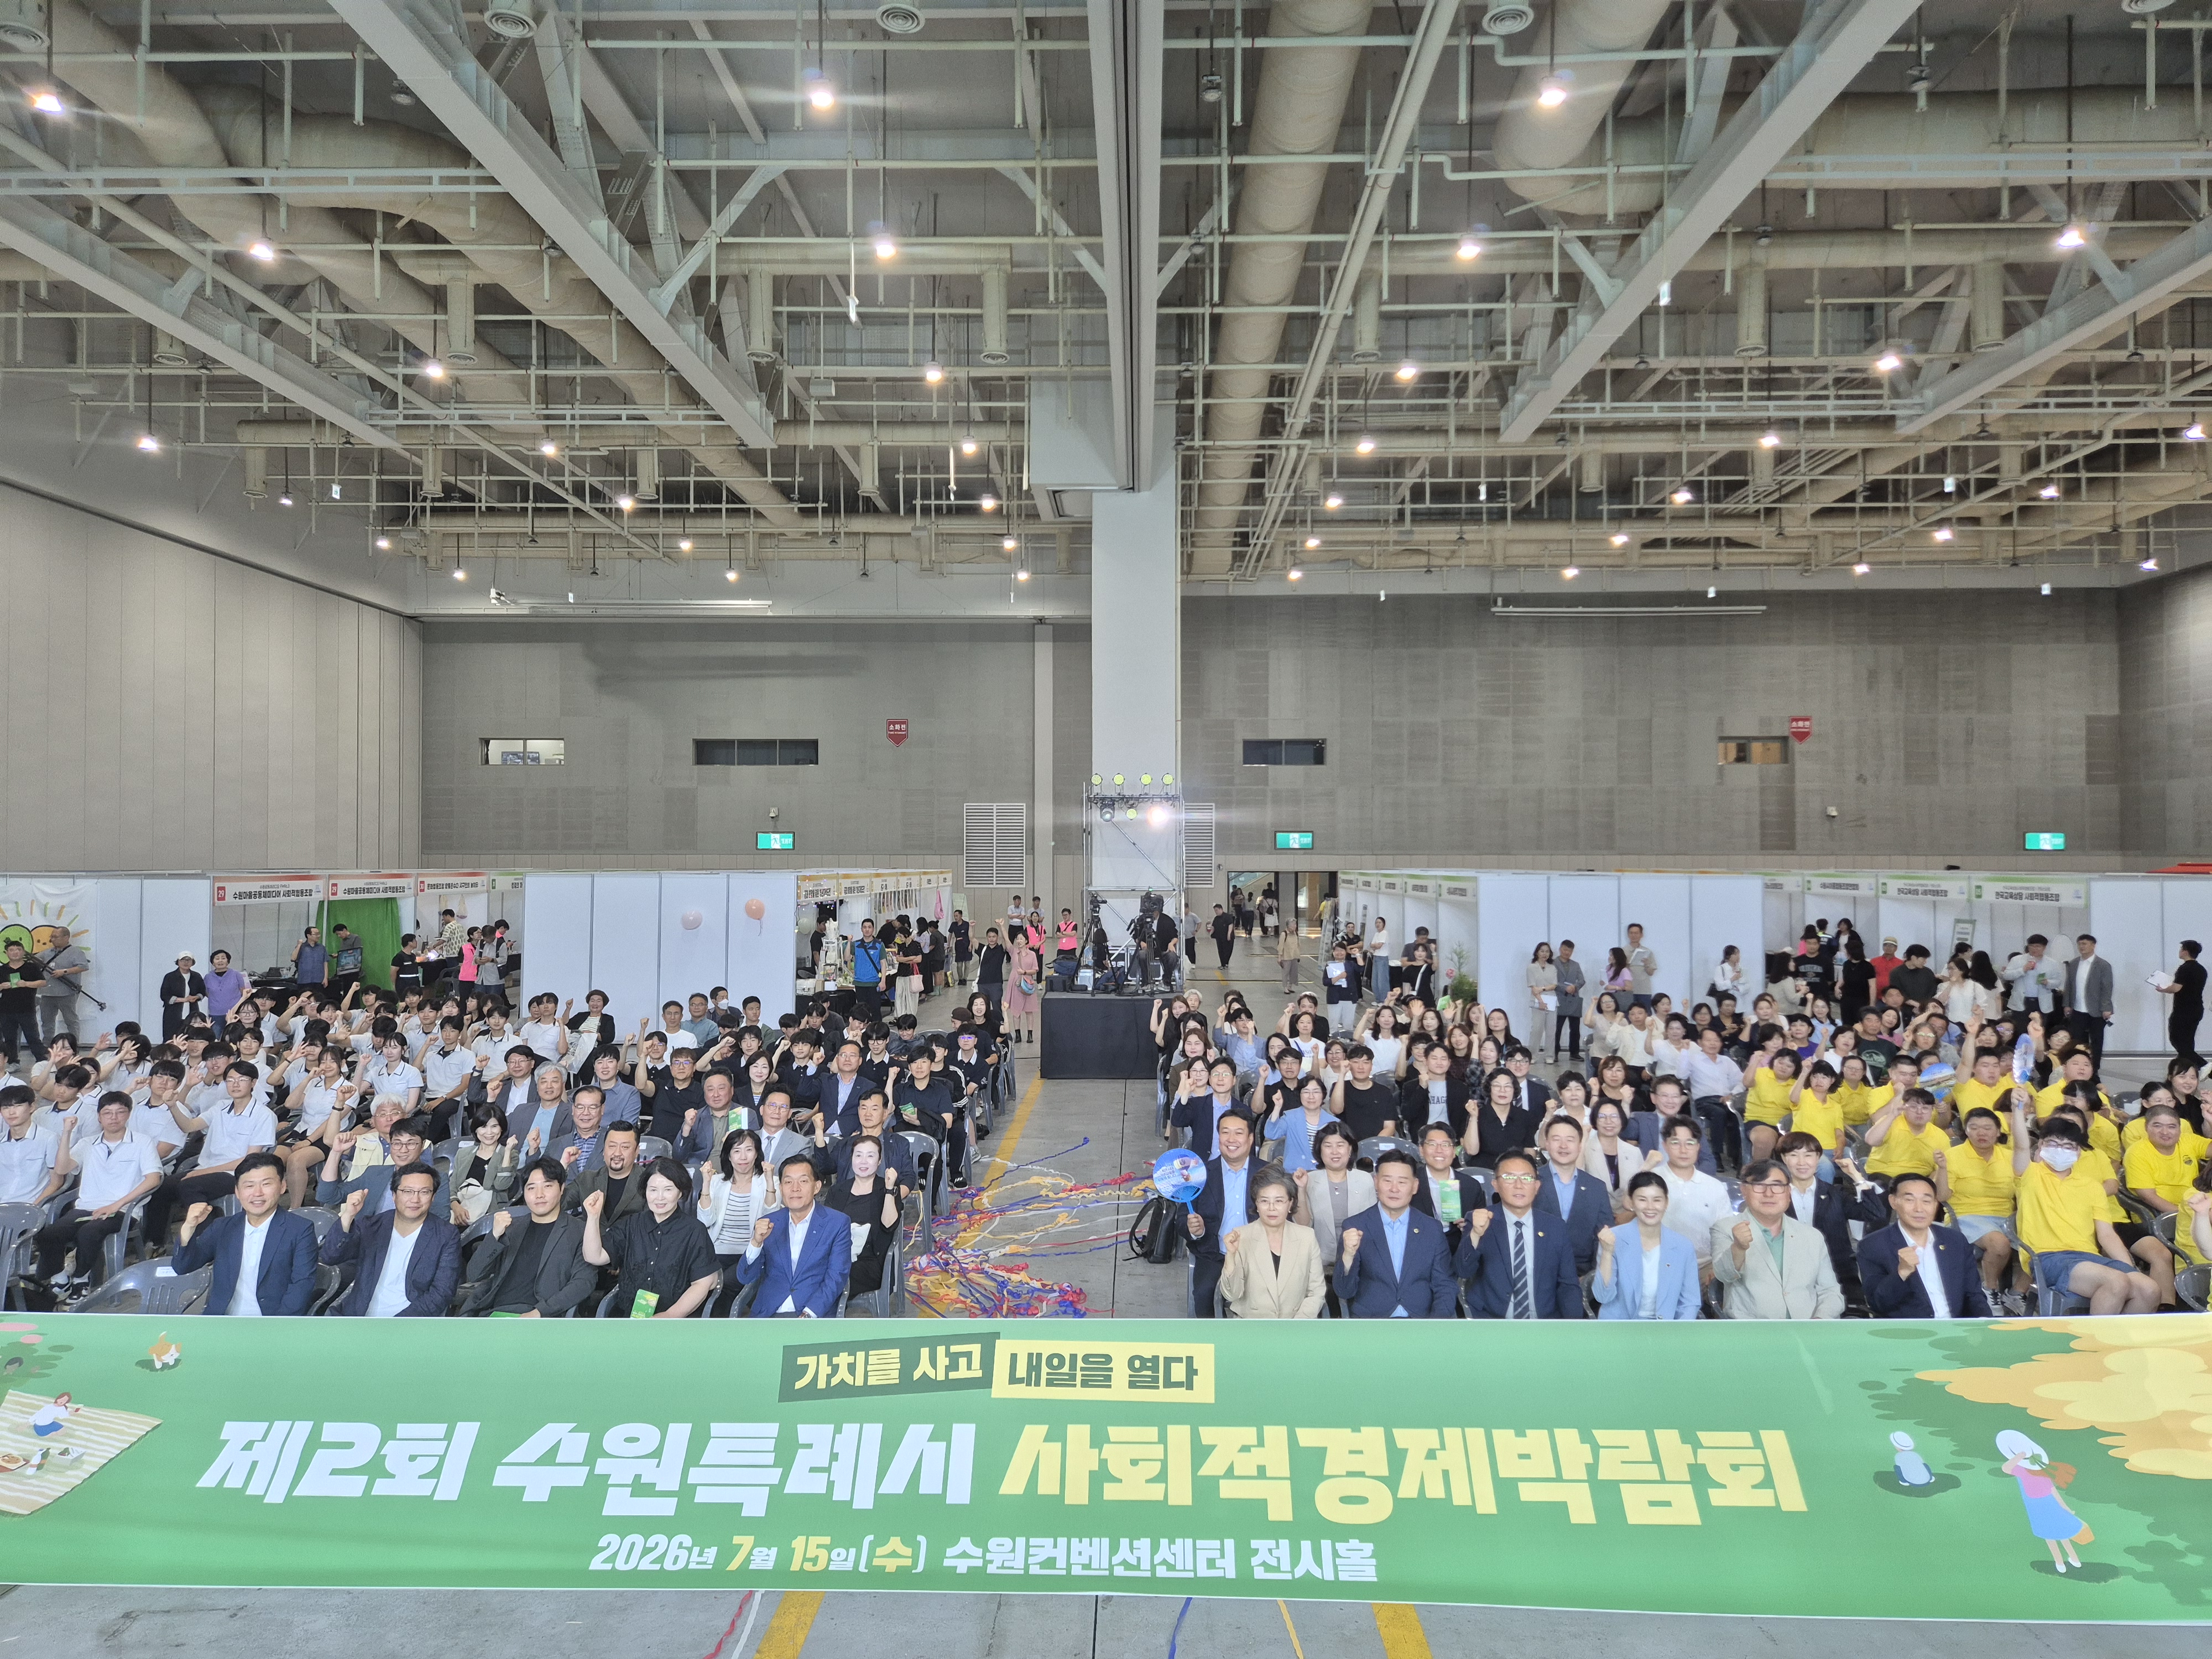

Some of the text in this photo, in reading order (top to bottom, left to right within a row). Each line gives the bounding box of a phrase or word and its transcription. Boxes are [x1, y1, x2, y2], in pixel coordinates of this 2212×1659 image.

[233, 889, 313, 900] 수원마을공동체미디어 사회적협동조합
[1995, 891, 2060, 902] 한국교육상담 사회적협동조합
[794, 1343, 983, 1390] 가치를 사고
[1008, 1352, 1199, 1391] 내일을 열다
[196, 1421, 1808, 1525] 제2회 수원특례시 사회적경제박람회
[589, 1533, 718, 1571] 2026년
[726, 1535, 778, 1572] 7월
[943, 1537, 1235, 1579] 수원컨벤션센터
[1250, 1539, 1378, 1582] 전시홀
